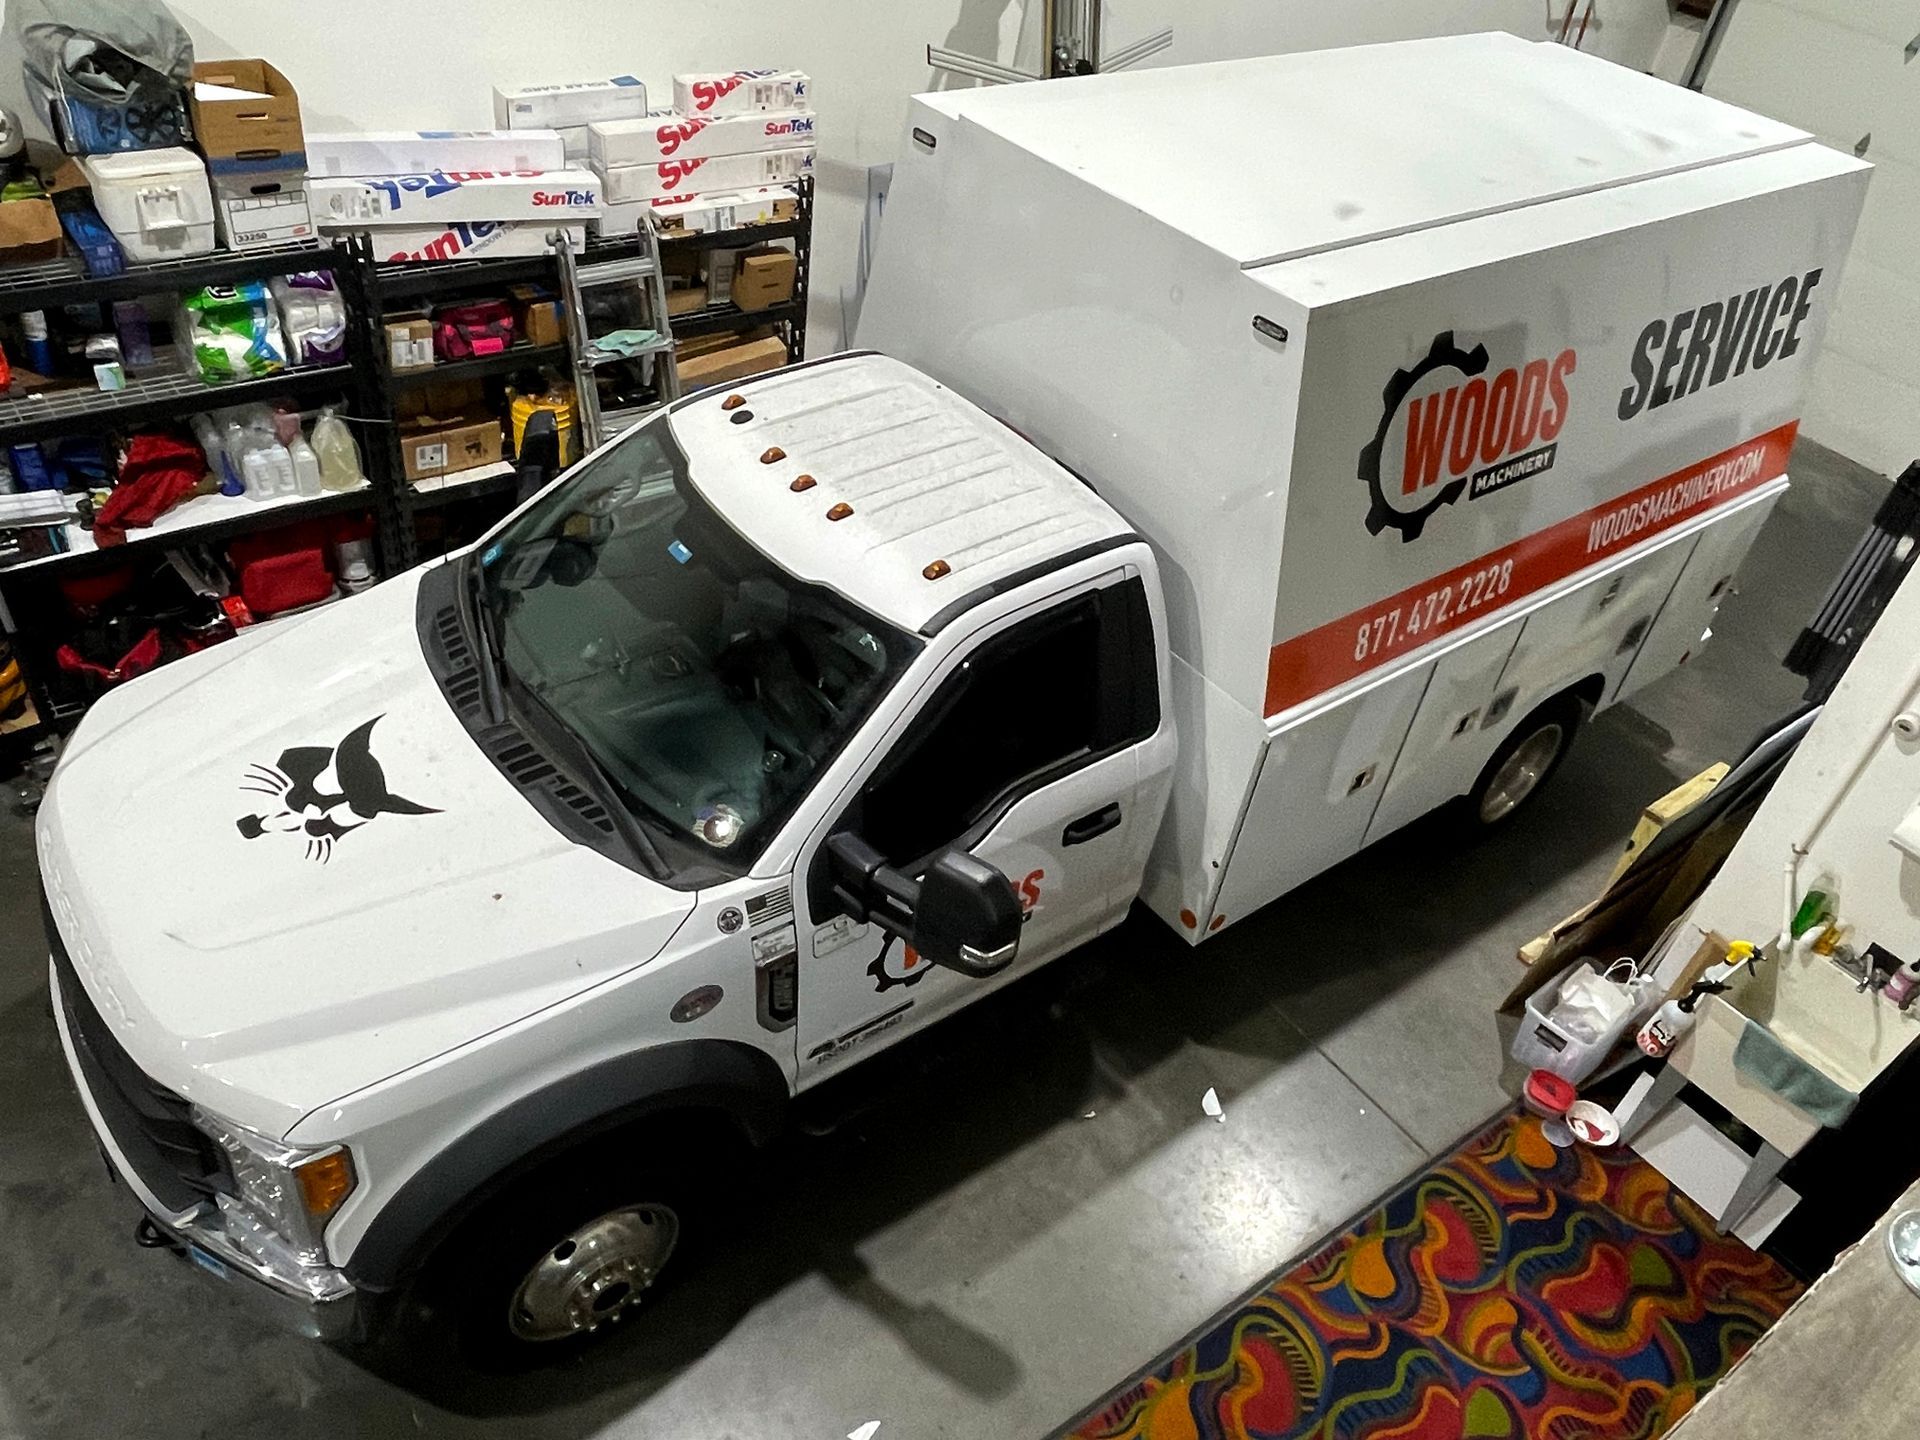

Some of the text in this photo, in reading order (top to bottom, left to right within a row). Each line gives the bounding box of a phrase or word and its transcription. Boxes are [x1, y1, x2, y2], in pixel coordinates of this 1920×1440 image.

[764, 117, 814, 136] SunTek
[531, 190, 595, 206] SunTek
[1617, 267, 1823, 422] SERVICE
[1402, 347, 1577, 496] WOODS
[1474, 449, 1552, 493] MACHINERY
[1354, 446, 1766, 661] 877.472.2228 WOODSMACHINERY.COM
